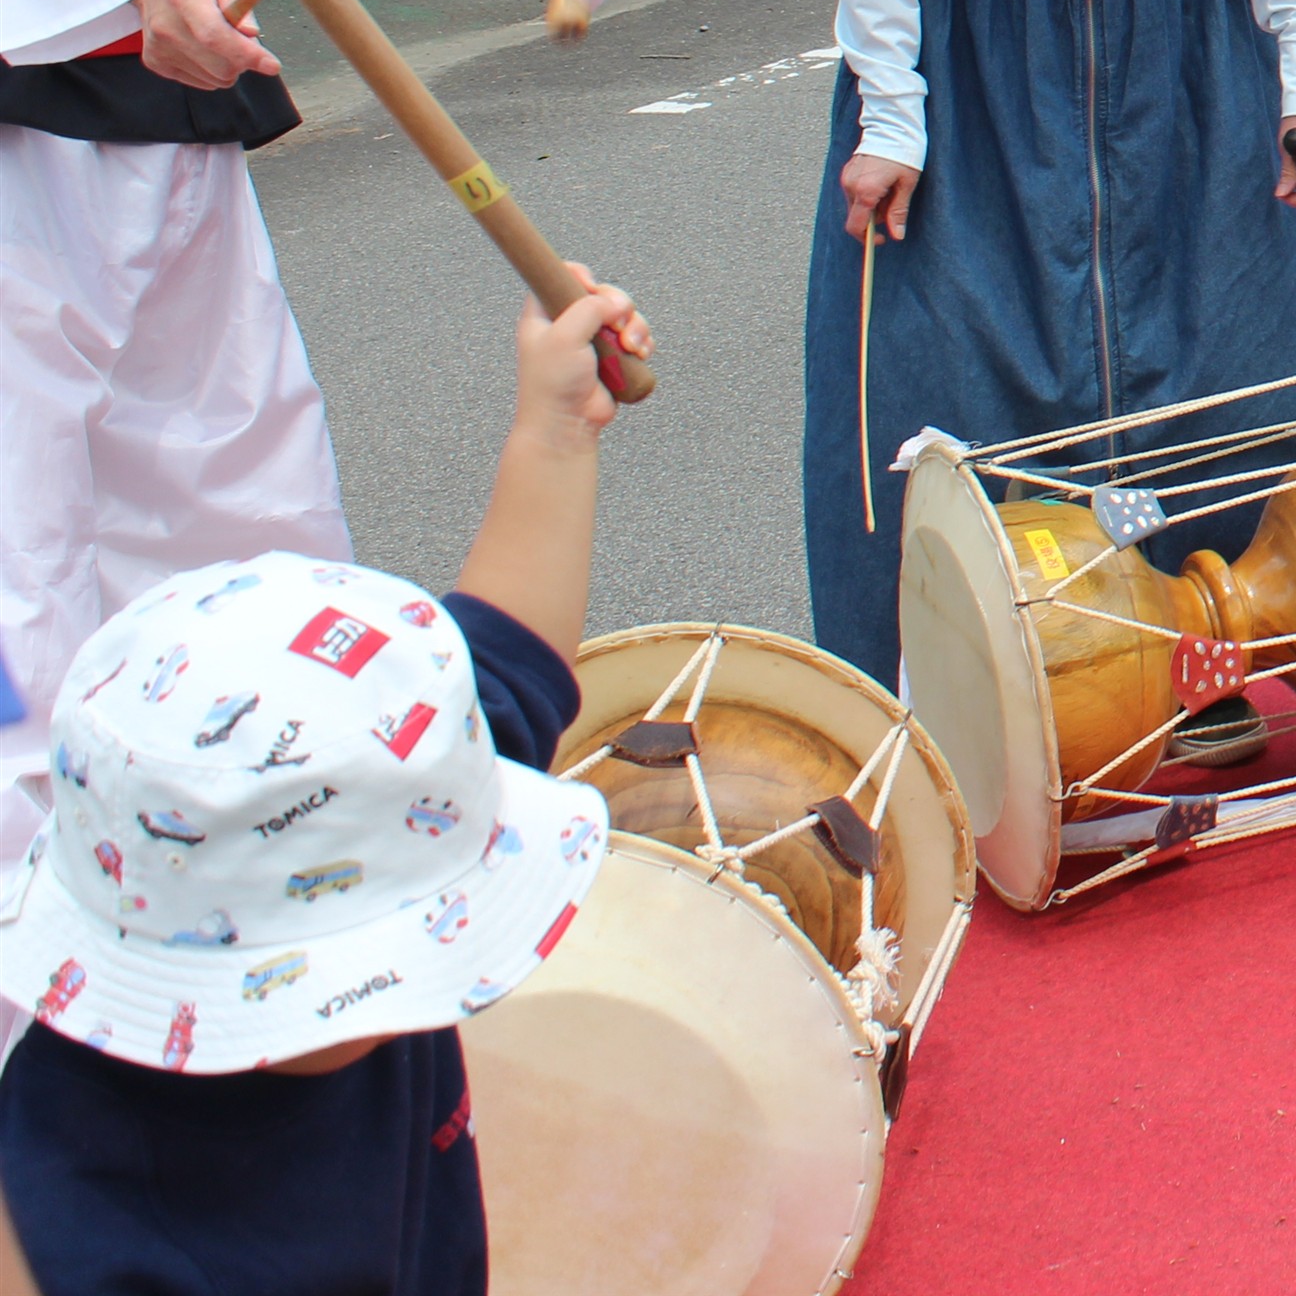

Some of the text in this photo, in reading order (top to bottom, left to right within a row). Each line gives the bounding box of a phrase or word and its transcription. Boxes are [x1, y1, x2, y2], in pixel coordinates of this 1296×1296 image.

[265, 718, 306, 766] MICA
[252, 784, 341, 839] TOMICA
[316, 968, 405, 1020] TOMICA
